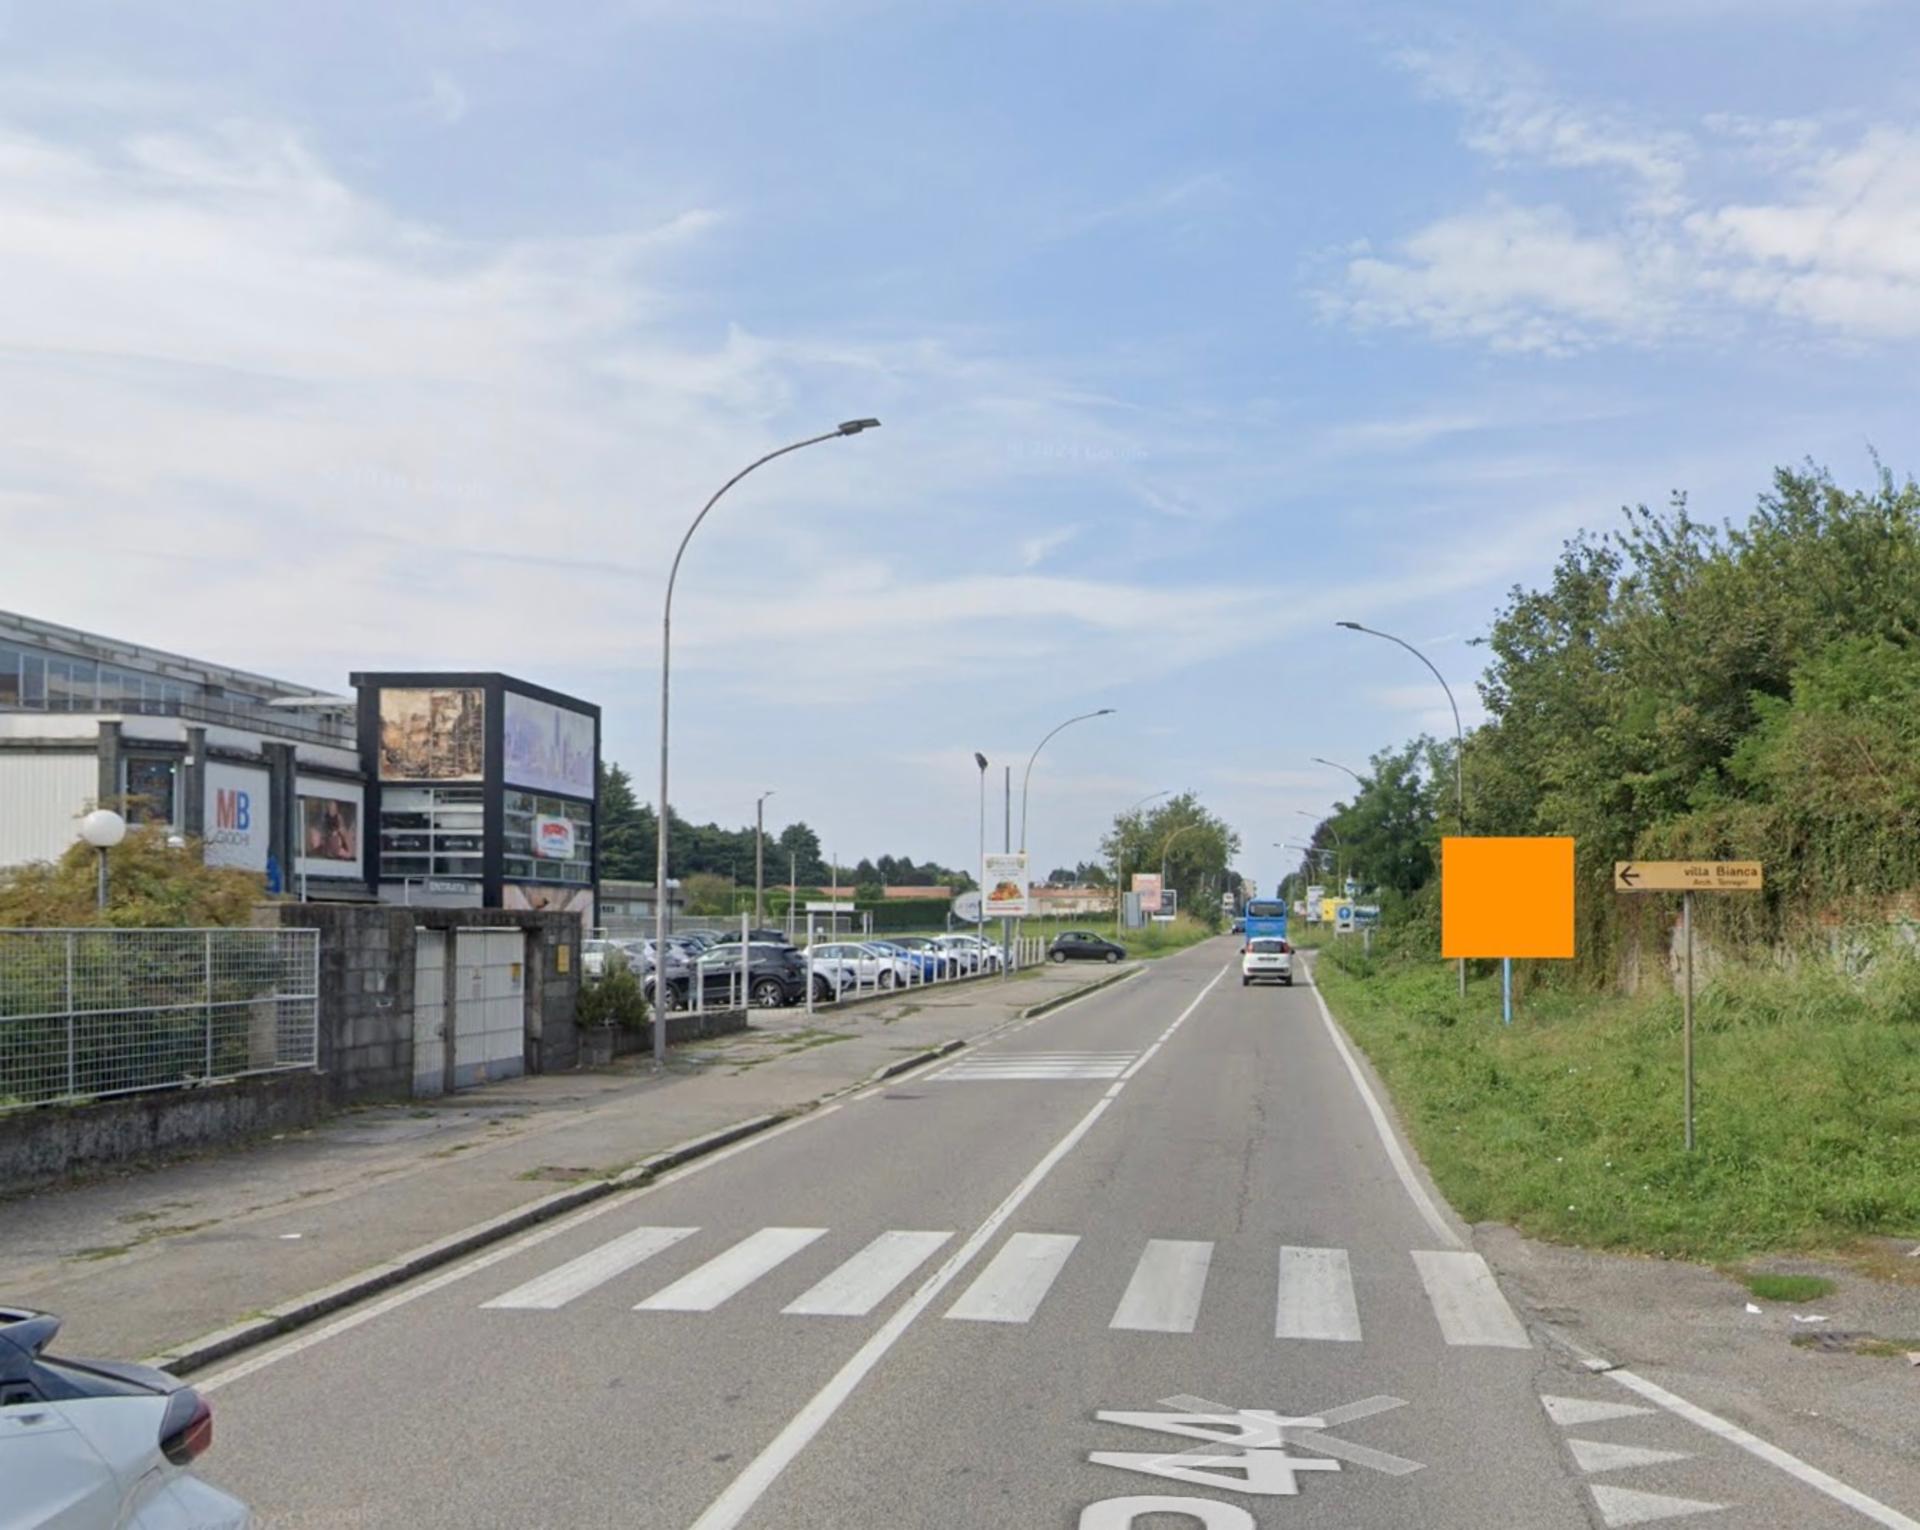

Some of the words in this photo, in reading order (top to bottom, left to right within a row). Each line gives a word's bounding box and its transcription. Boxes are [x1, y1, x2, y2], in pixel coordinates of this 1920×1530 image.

[216, 788, 250, 830] MB
[1684, 866, 1710, 877] villa
[1716, 866, 1758, 877] Bianca
